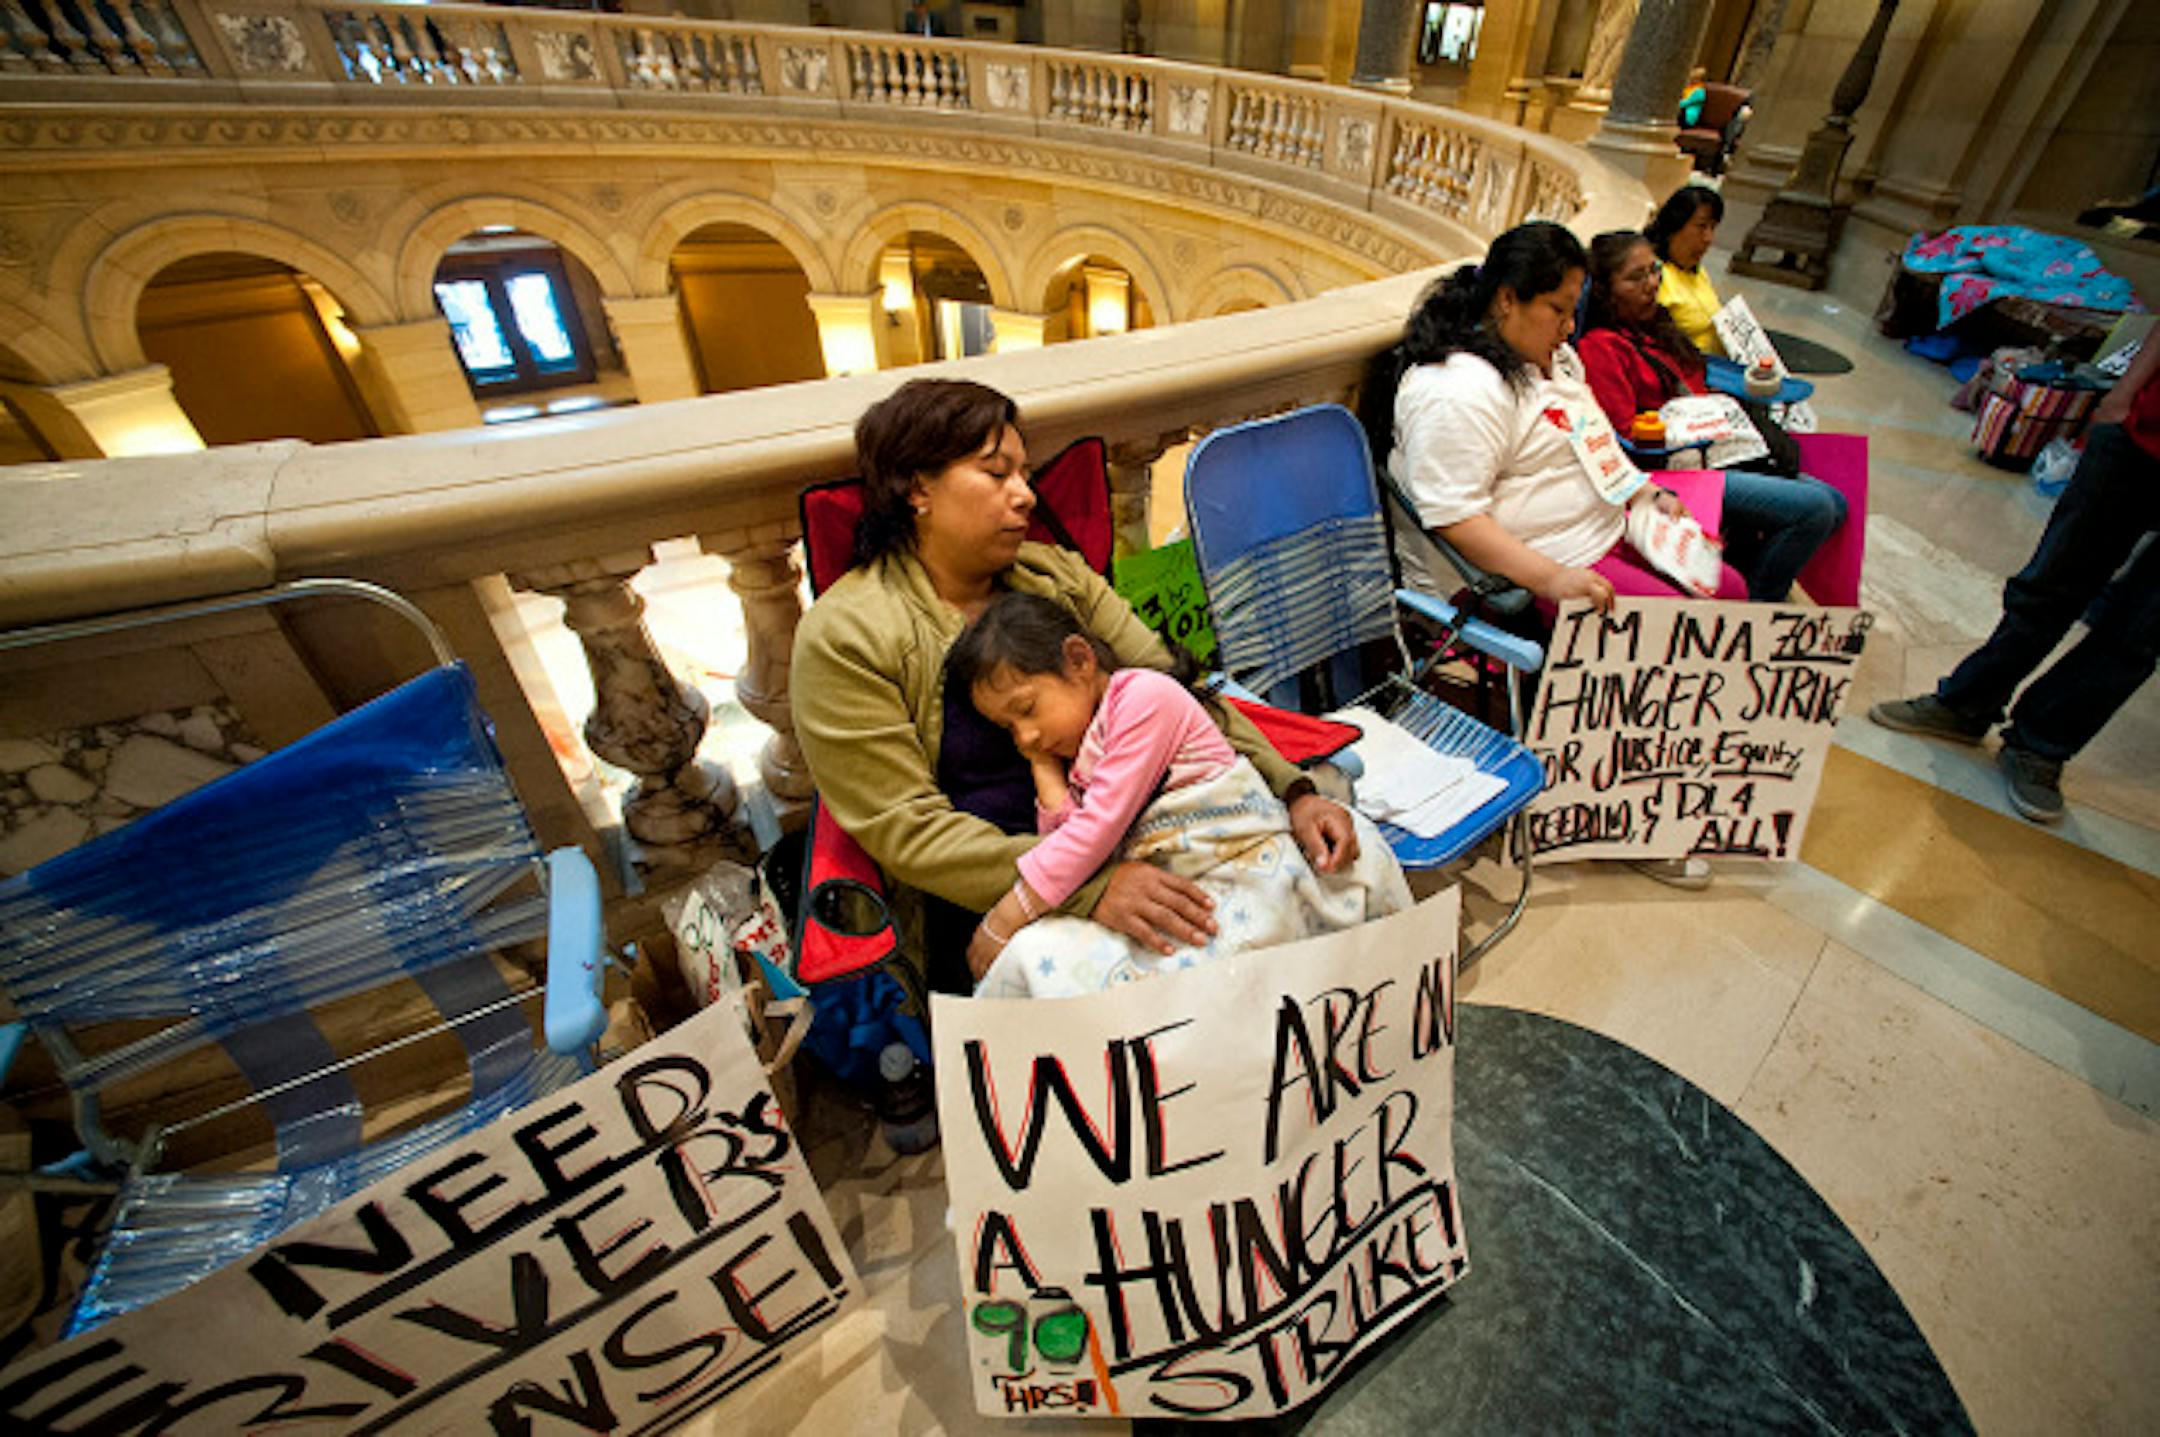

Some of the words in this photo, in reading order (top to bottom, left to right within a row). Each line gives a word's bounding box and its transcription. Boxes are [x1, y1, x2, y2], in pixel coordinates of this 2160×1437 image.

[1535, 665, 1726, 740] HUNGER
[1534, 741, 1582, 791] OR
[1731, 782, 1755, 816] 4
[1694, 811, 1795, 857] ALL!
[964, 1018, 1225, 1191] WE
[1265, 979, 1396, 1166] ARE
[1412, 951, 1455, 1060] ON
[247, 1054, 713, 1323] NEED
[973, 1210, 1043, 1296] A
[1083, 1090, 1427, 1360] HUNGER
[1146, 1180, 1466, 1415] STRIKE!
[971, 1299, 1090, 1373] 90
[1003, 1378, 1098, 1414] HRS!
